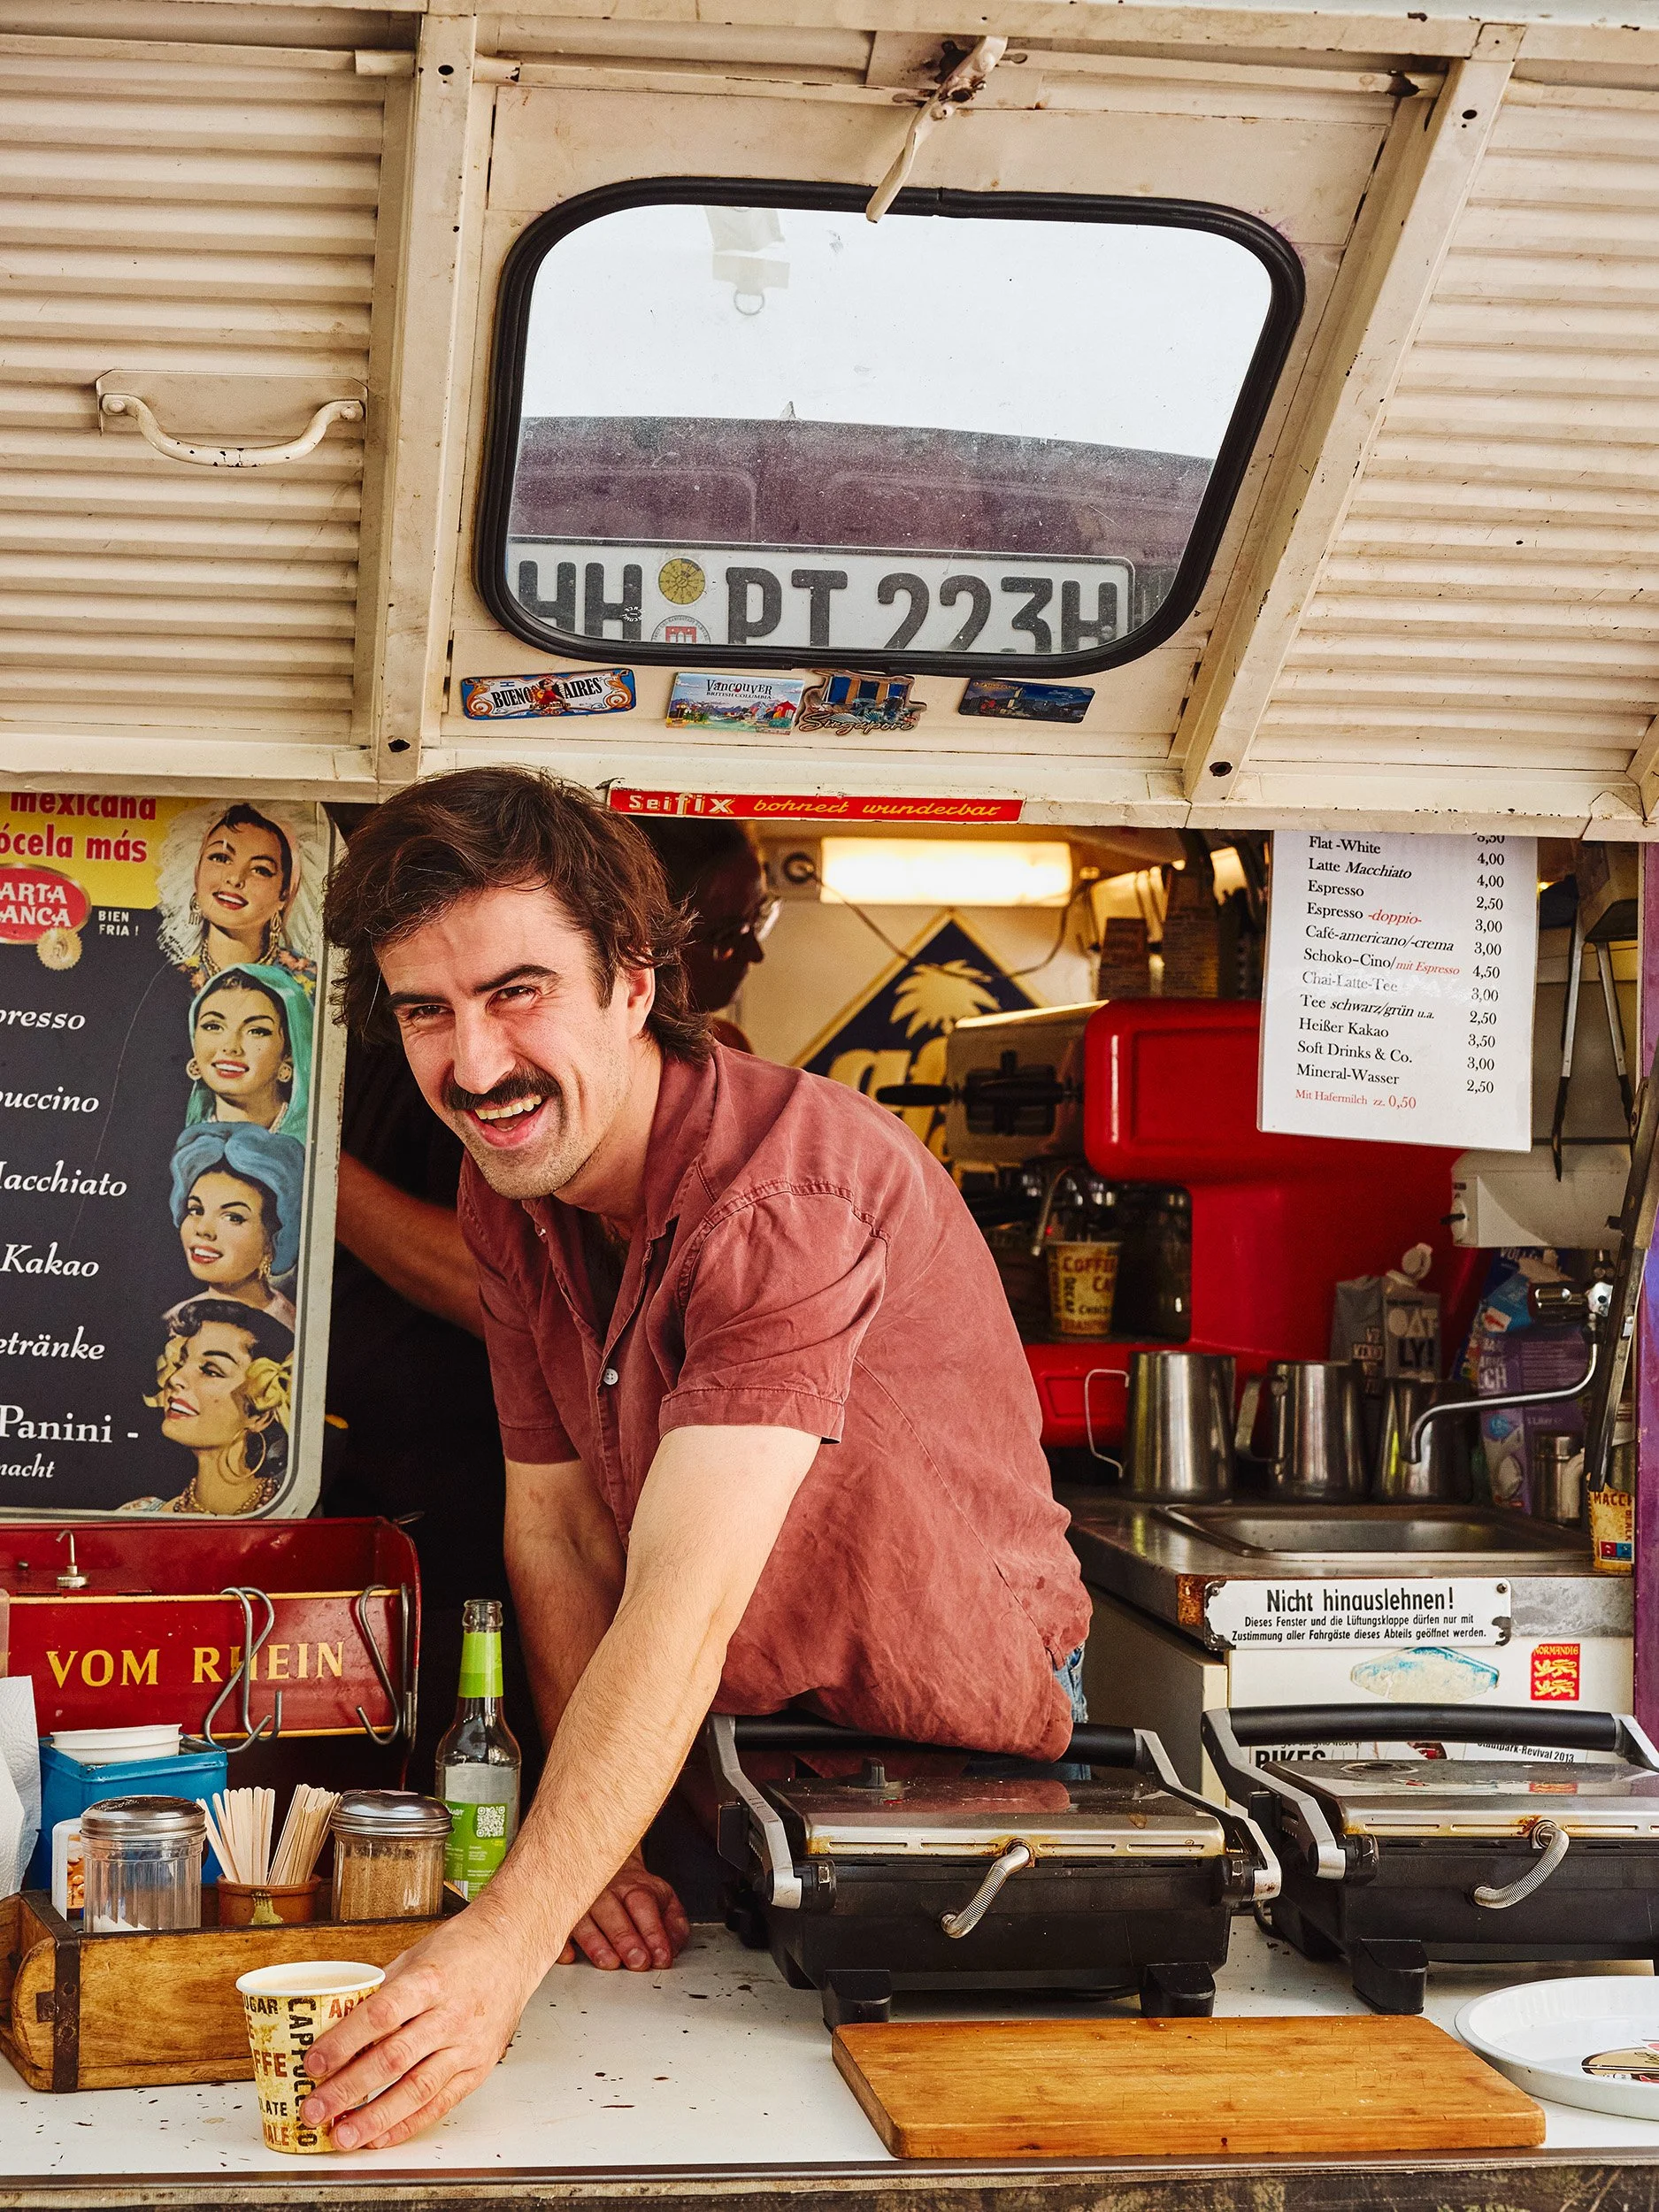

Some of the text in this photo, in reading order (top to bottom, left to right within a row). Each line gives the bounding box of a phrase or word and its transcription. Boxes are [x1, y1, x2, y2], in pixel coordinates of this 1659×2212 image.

[518, 560, 643, 641] HH
[726, 566, 849, 647] PT
[491, 677, 603, 708] BUENO AIRES
[799, 711, 915, 736] Singapore
[11, 792, 157, 821] mexicana
[629, 793, 1000, 817] Seifix bohnert wunderbar
[86, 829, 148, 864] más
[1309, 836, 1333, 849] Flat
[1477, 853, 1505, 867] 4,00
[1309, 858, 1505, 889] Latte Macchiato 4,00
[0, 882, 67, 905] ARTA
[1308, 880, 1504, 911] Espresso 2,50
[98, 910, 130, 923] BIEN
[99, 924, 131, 937] FRIA
[1307, 902, 1503, 933] Espresso -doppio- 3,00
[1474, 942, 1502, 957] 3,00
[1416, 962, 1461, 976] Espresso
[1472, 966, 1501, 979] 4,50
[1302, 971, 1499, 1002] Chai-Latte-Tee 3,00
[1300, 995, 1497, 1025] Tee schwarz/grün u.a. 2,50
[1299, 1018, 1496, 1048] Heißer Kakao 3,50
[1297, 1041, 1495, 1071] Soft Drinks & Co. 3,00
[1296, 1064, 1494, 1094] Mineral-Wasser 2,50
[1295, 1089, 1312, 1100] Mit
[1315, 1091, 1368, 1105] Hafermilch
[1388, 1095, 1417, 1110] 0,50
[2, 1242, 100, 1278] Kakao
[1387, 1307, 1439, 1339] OAT
[1398, 1338, 1435, 1367] LY!
[0, 1404, 112, 1443] Panini
[1267, 1588, 1313, 1612] Nicht
[1232, 1627, 1486, 1642] Zustimmung aller Fahrgäste dieses Abteils geöffnet werden.
[1245, 1614, 1474, 1628] Dieses Fenster und die Lüftungsklappe dürfen nur mit
[47, 1641, 346, 1689] VOM RHEIN
[1554, 1751, 1575, 1763] 2013
[288, 1998, 318, 2147] CAPPUCCO
